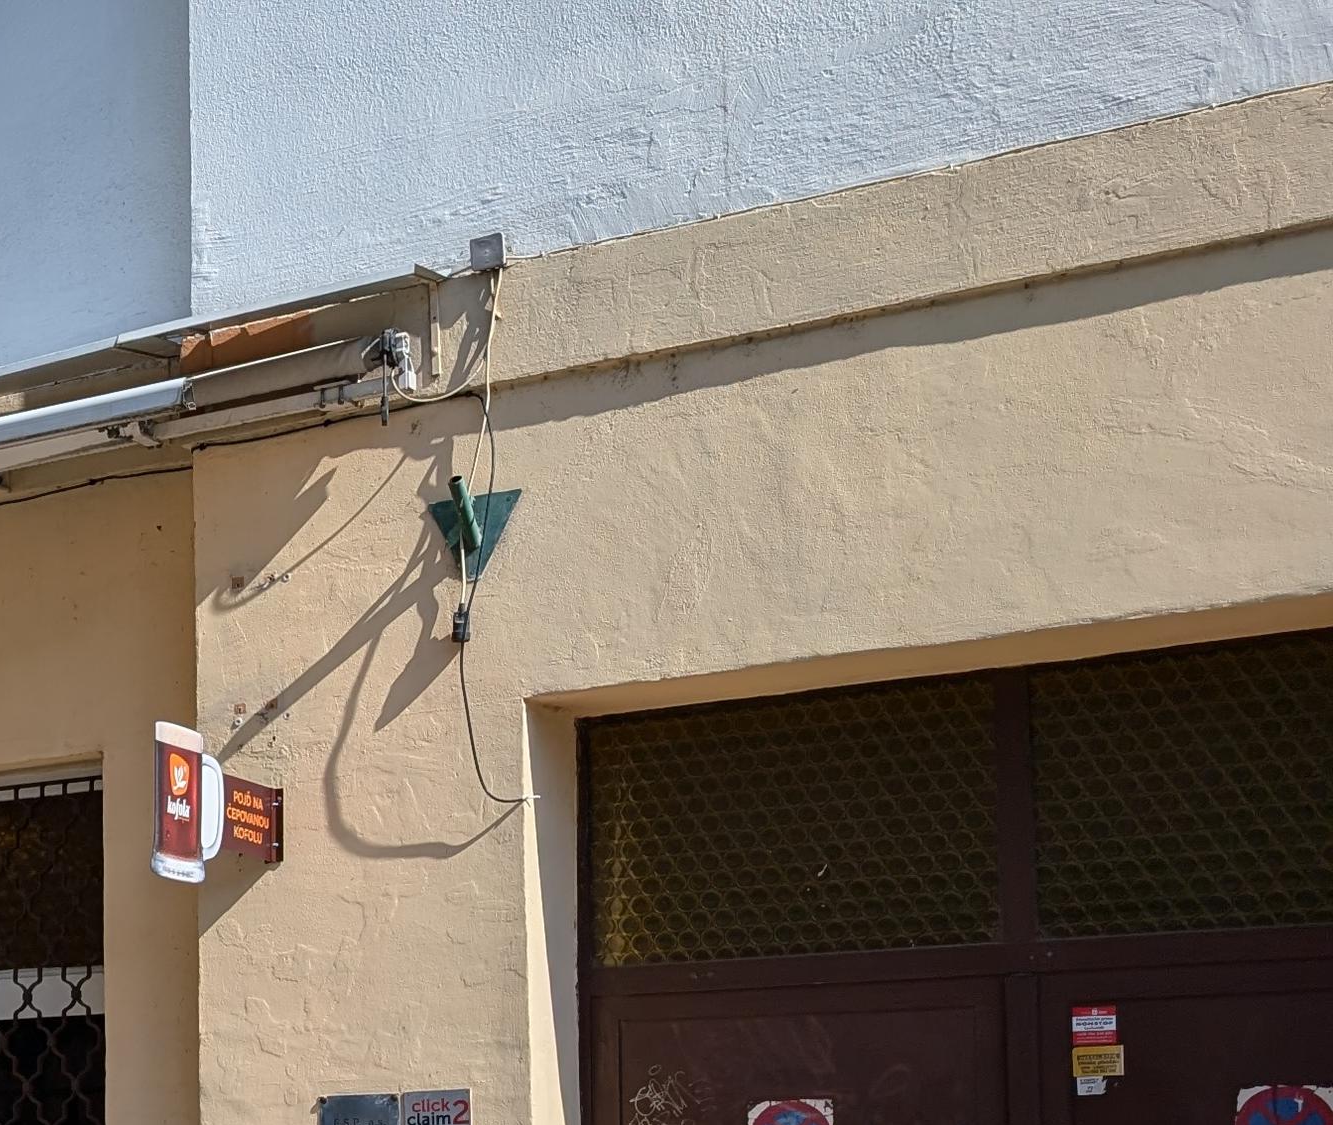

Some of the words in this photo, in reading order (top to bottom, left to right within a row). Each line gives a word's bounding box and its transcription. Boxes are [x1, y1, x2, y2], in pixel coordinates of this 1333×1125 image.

[166, 795, 190, 820] kofola
[253, 797, 264, 811] NA
[226, 804, 270, 830] ČEPOVANOU
[233, 826, 262, 844] KOFOLU
[412, 1098, 450, 1112] click
[453, 1099, 470, 1125] 2
